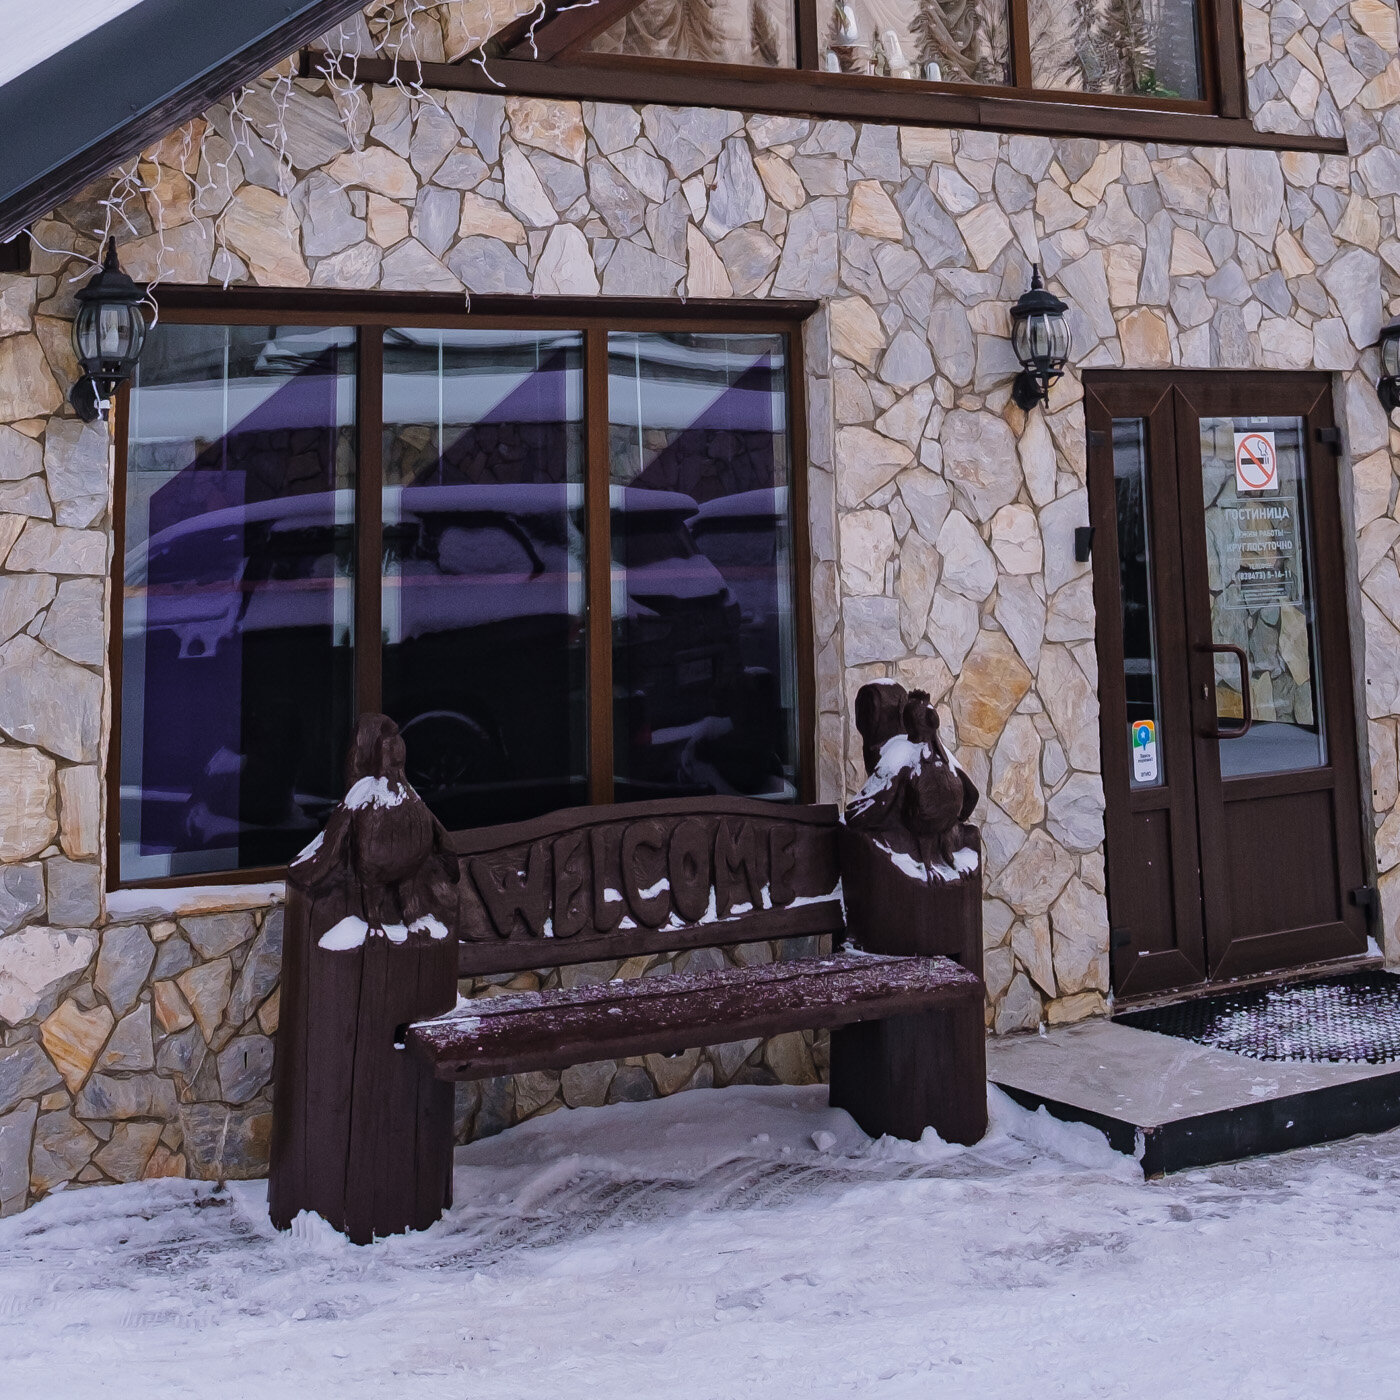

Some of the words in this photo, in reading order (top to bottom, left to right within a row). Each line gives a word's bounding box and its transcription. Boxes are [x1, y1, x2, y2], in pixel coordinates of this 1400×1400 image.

[1225, 506, 1290, 521] ГОСТИНИЦА
[1226, 540, 1293, 553] КРУГЛОСУТОЧНО
[468, 818, 797, 939] WELCOME
